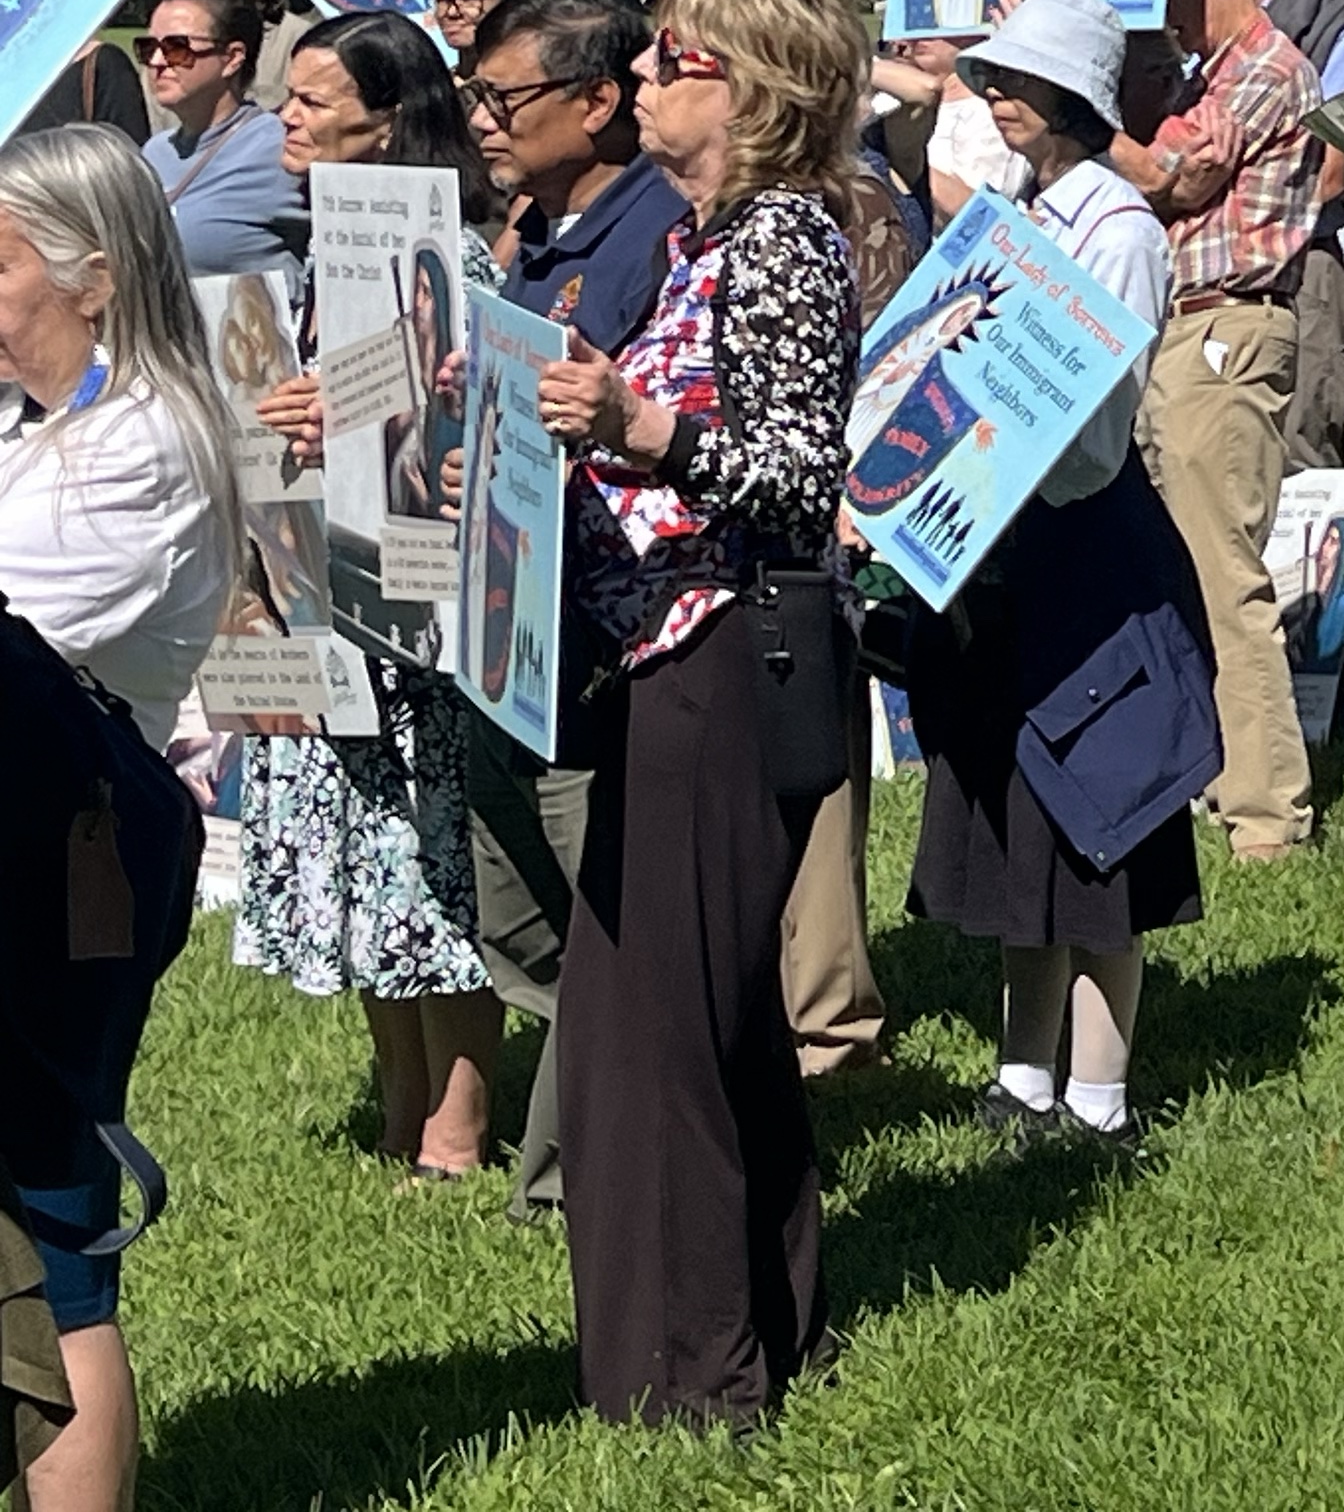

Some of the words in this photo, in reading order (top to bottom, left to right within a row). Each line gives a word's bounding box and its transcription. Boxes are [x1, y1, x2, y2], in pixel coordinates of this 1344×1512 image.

[990, 223, 1017, 256] Our
[1014, 244, 1049, 291] Lady
[1047, 284, 1070, 302] of
[1066, 295, 1126, 358] Sorrows
[987, 324, 1012, 354] Our
[1008, 343, 1075, 414] Immigrant
[1015, 300, 1066, 359] Witness
[1060, 346, 1087, 376] for
[976, 360, 1038, 428] Neighbors
